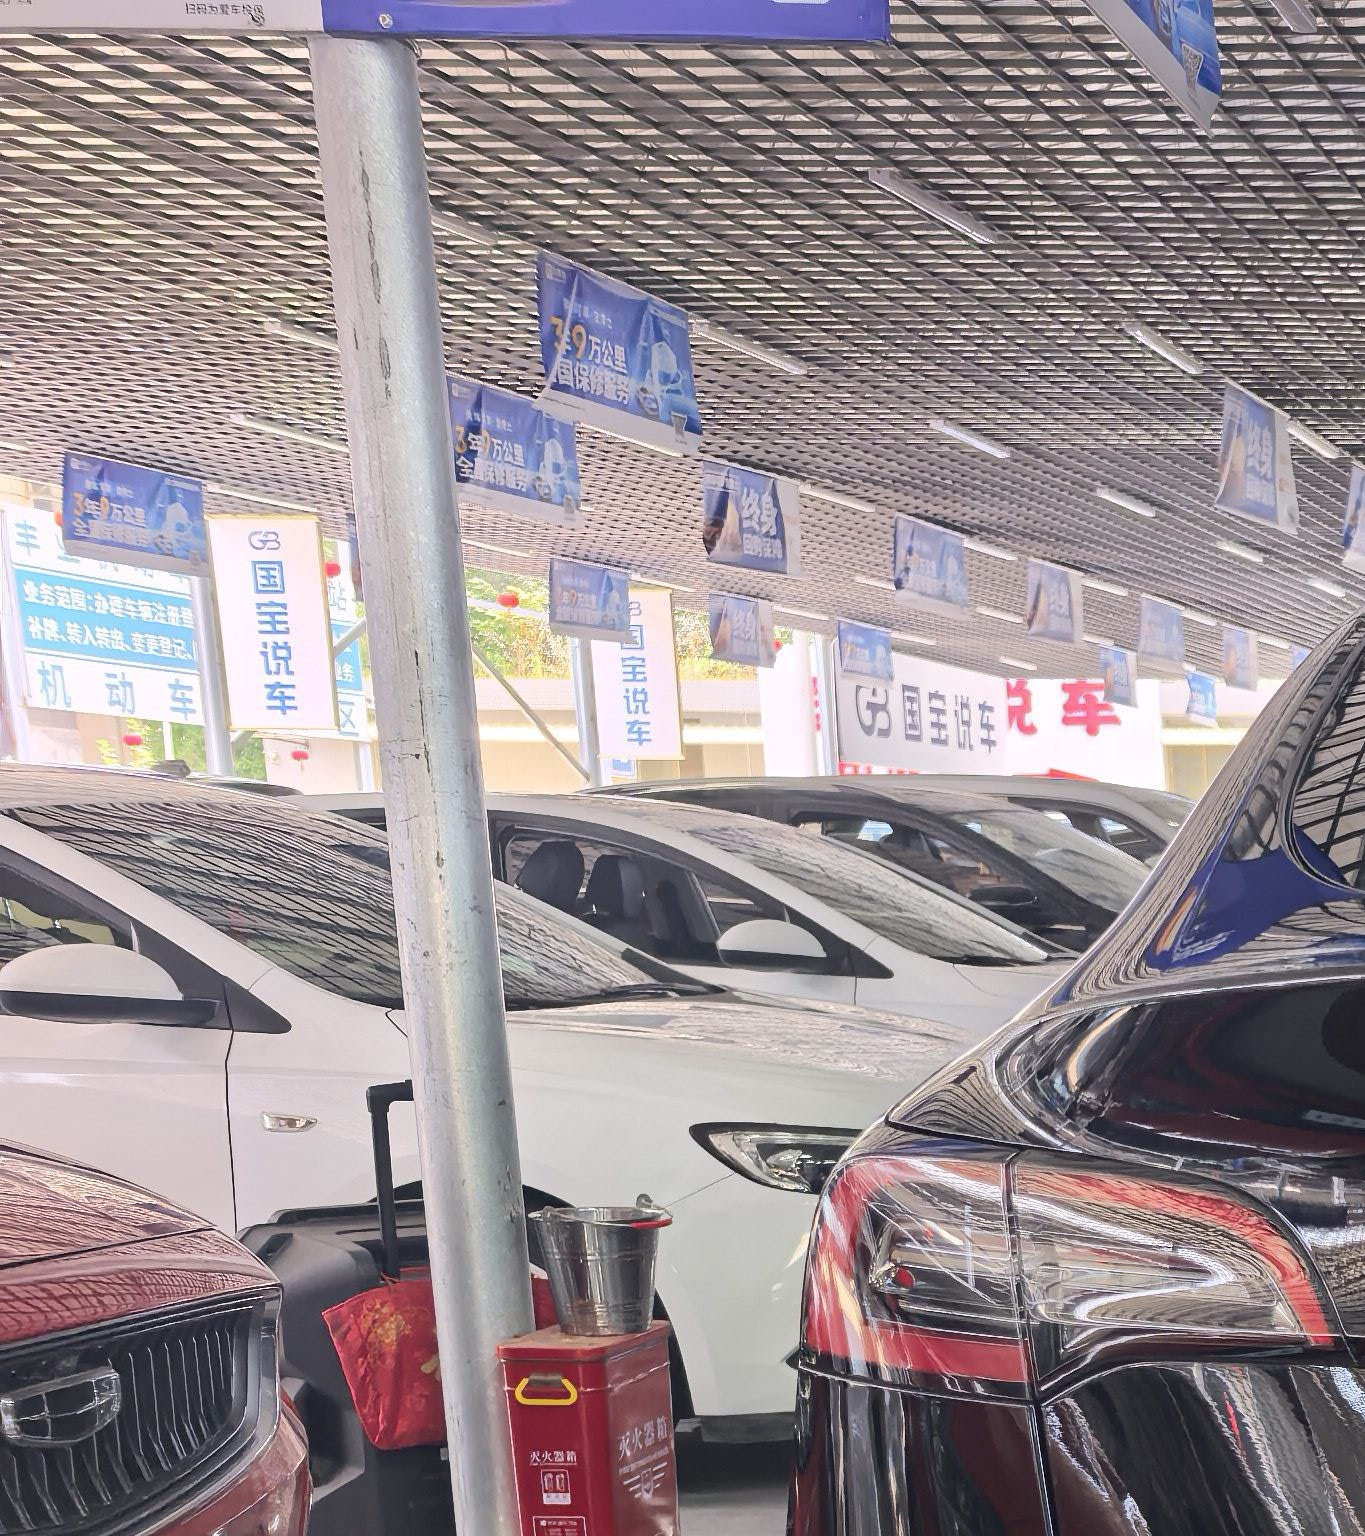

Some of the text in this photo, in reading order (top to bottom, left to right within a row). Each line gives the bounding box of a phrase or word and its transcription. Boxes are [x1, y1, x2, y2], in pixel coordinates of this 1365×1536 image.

[251, 560, 298, 716] 国宝说车
[902, 684, 997, 754] 国宝说车
[530, 1450, 577, 1464] 灭火器箱
